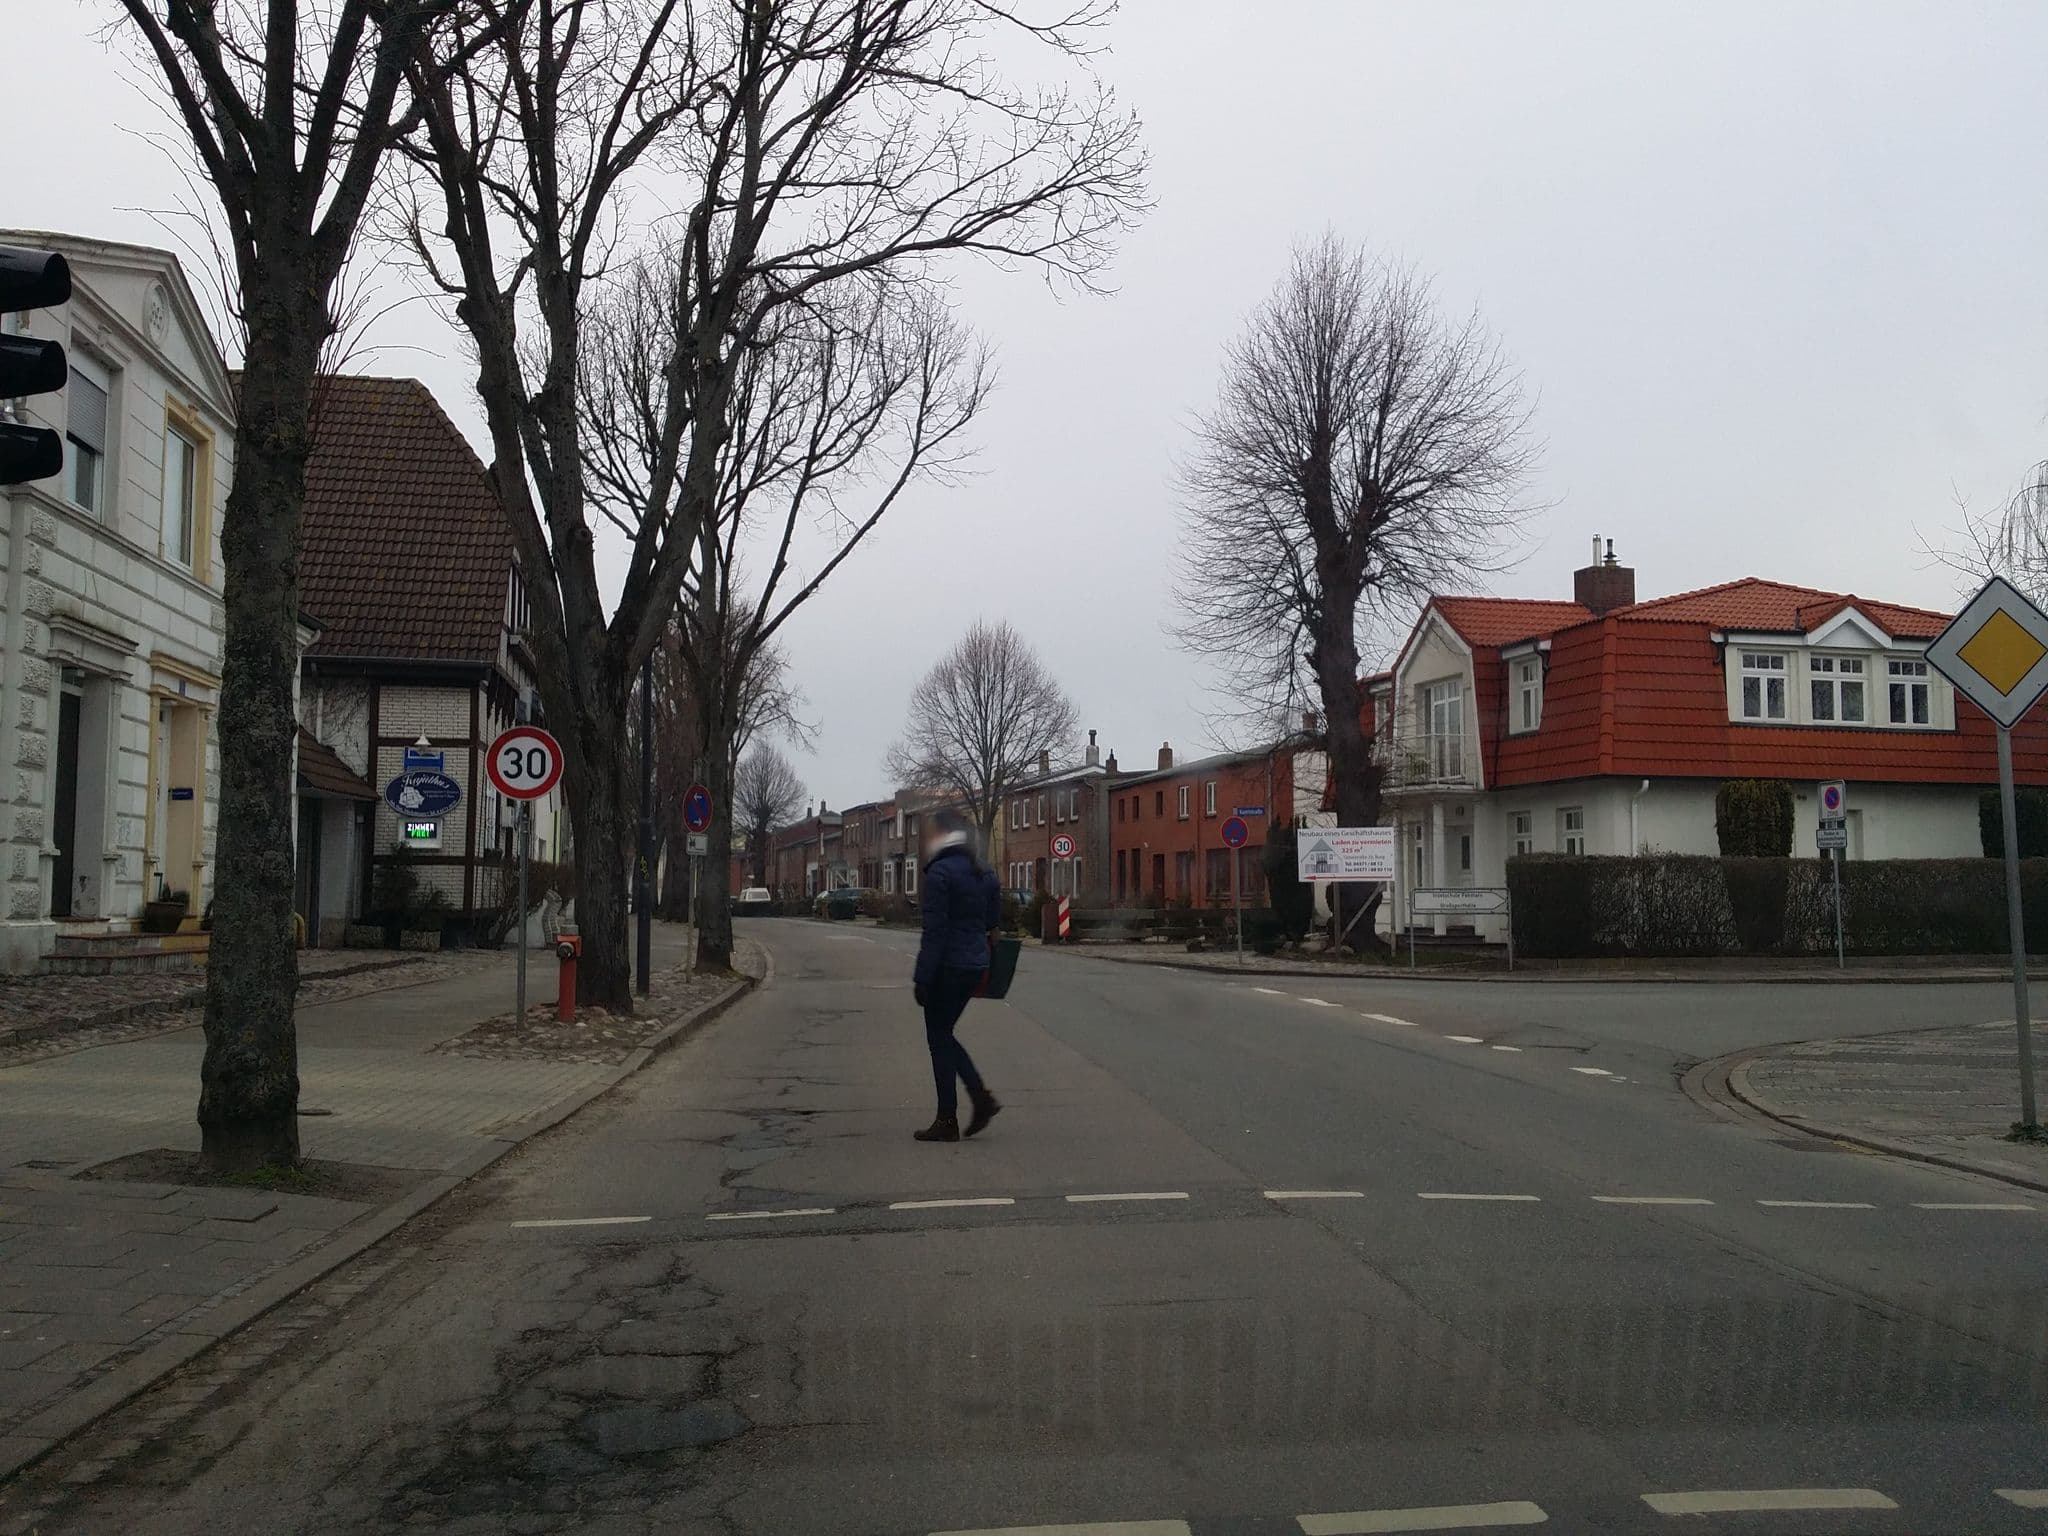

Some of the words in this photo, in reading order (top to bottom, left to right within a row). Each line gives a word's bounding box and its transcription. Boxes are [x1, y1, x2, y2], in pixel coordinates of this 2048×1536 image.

[503, 747, 546, 779] 30
[407, 823, 435, 832] ZIMMER
[1056, 840, 1070, 852] 30
